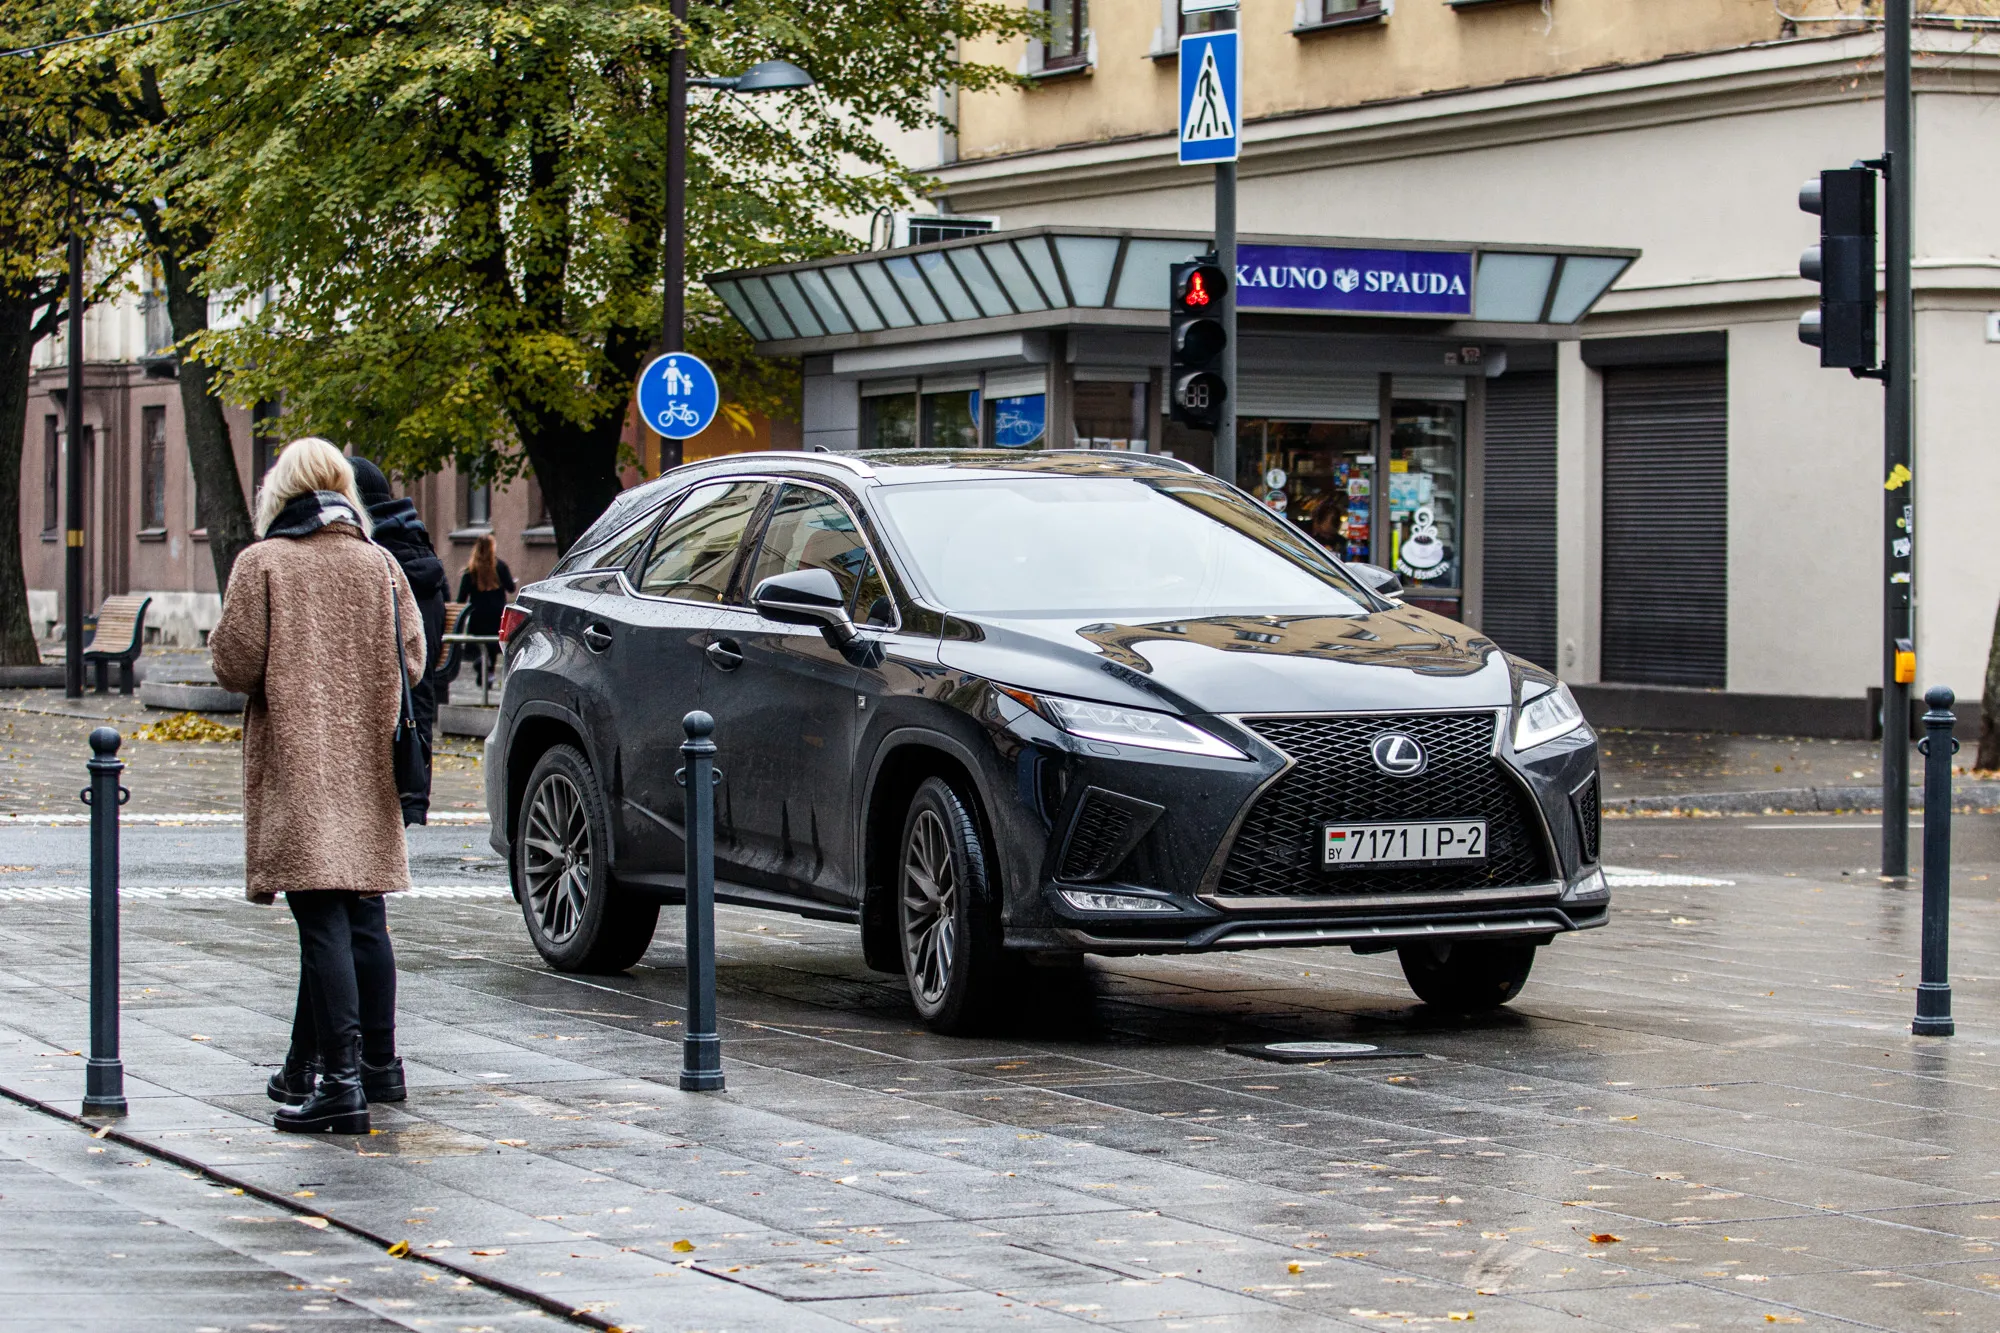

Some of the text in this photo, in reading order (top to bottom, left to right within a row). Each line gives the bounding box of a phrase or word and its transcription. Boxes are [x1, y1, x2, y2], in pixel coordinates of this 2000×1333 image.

[1235, 265, 1467, 296] KAUNO SPAUDA
[1328, 847, 1343, 860] BY
[1351, 829, 1408, 860] 7171
